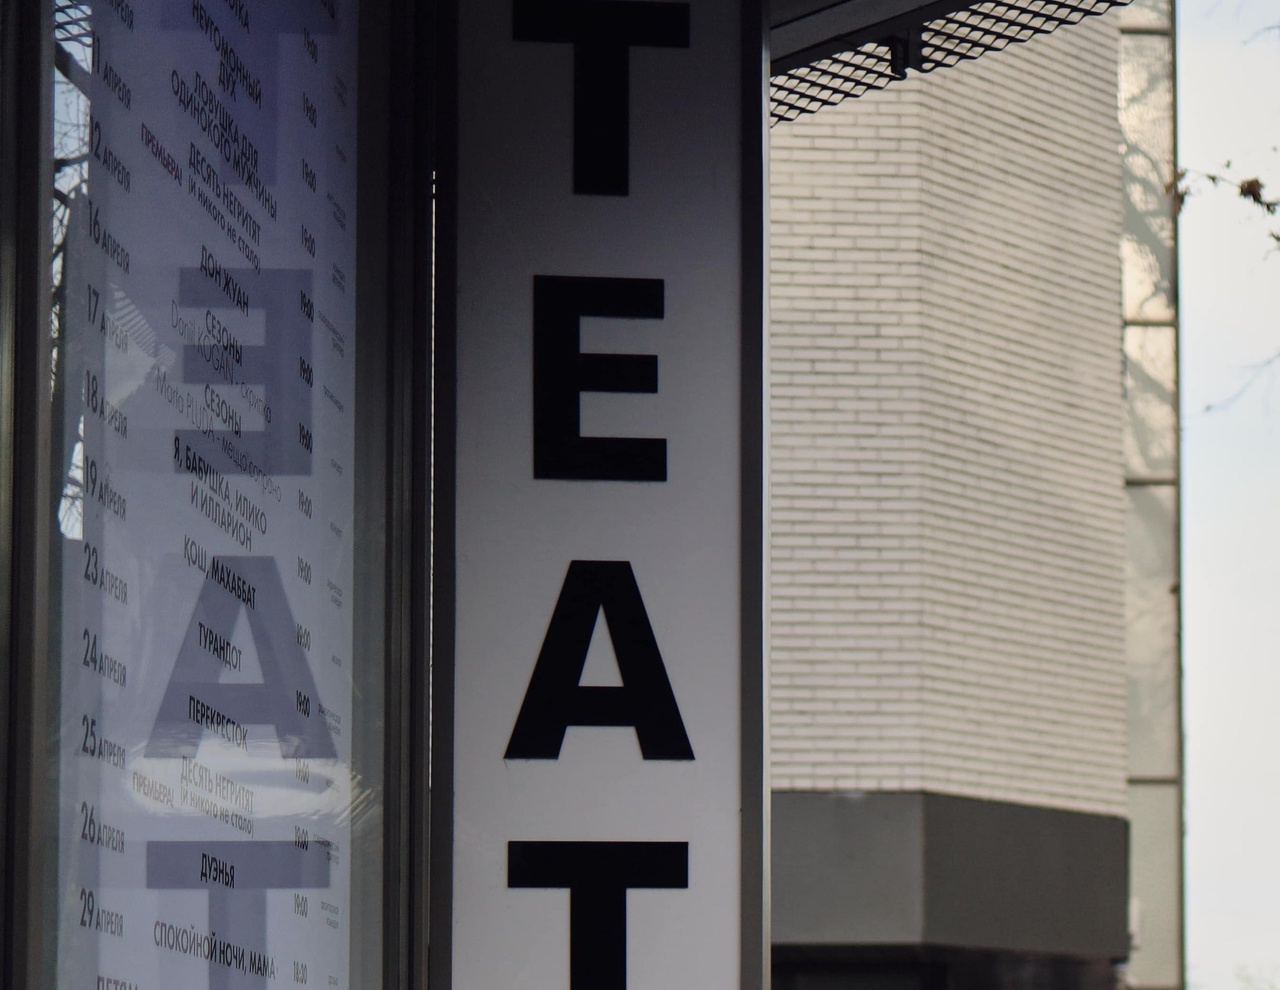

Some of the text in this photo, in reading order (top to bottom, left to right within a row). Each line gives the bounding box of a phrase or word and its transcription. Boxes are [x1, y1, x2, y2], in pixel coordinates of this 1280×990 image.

[92, 32, 131, 110] 11 АПРЕЛЯ
[219, 60, 237, 103] ДУХ
[171, 69, 277, 222] ОДИНОКОГО МУЖЧИНЫ
[195, 71, 240, 150] ЛОВУШКА
[240, 133, 259, 173] ДЛЯ
[90, 113, 130, 192] 12 АПРЕЛЯ
[141, 122, 183, 187] ПРЕМЬЕРА!
[189, 141, 260, 246] ДЕСЯТЬ НЕГРИТЯТ
[89, 199, 130, 274] 16 АПРЕЛЯ
[87, 284, 99, 325] 17
[200, 244, 249, 317] ДОН ЖУАН
[205, 309, 242, 367] СЕЗОНЫ
[86, 370, 98, 414] 18
[204, 383, 242, 439] СЕЗОНЫ
[84, 455, 126, 521] 19 АПРЕЛЯ
[185, 444, 232, 511] БАБУШКА,
[235, 489, 267, 535] ИЛИКО
[191, 480, 252, 552] И ИЛЛАРИОН
[83, 542, 127, 605] 23 АПРЕЛЯ
[211, 556, 256, 609] МАХАББАТ
[83, 629, 126, 687] 24 АПРЕЛЯ
[198, 621, 242, 672] ТУРАНДОТ
[81, 715, 125, 770] 25 АПРЕЛЯ
[188, 695, 248, 751] ПЕРЕКРЕСТОК
[181, 755, 254, 814] ДЕСЯТЬ НЕГРИТЯТ
[80, 801, 125, 854] 26 АПРЕЛЯ
[200, 852, 235, 888] ДУЭНЬЯ
[79, 888, 123, 937] 29 АПРЕЛЯ
[153, 916, 276, 980] СПОКОЙНОЙ НОЧИ, МАМА
